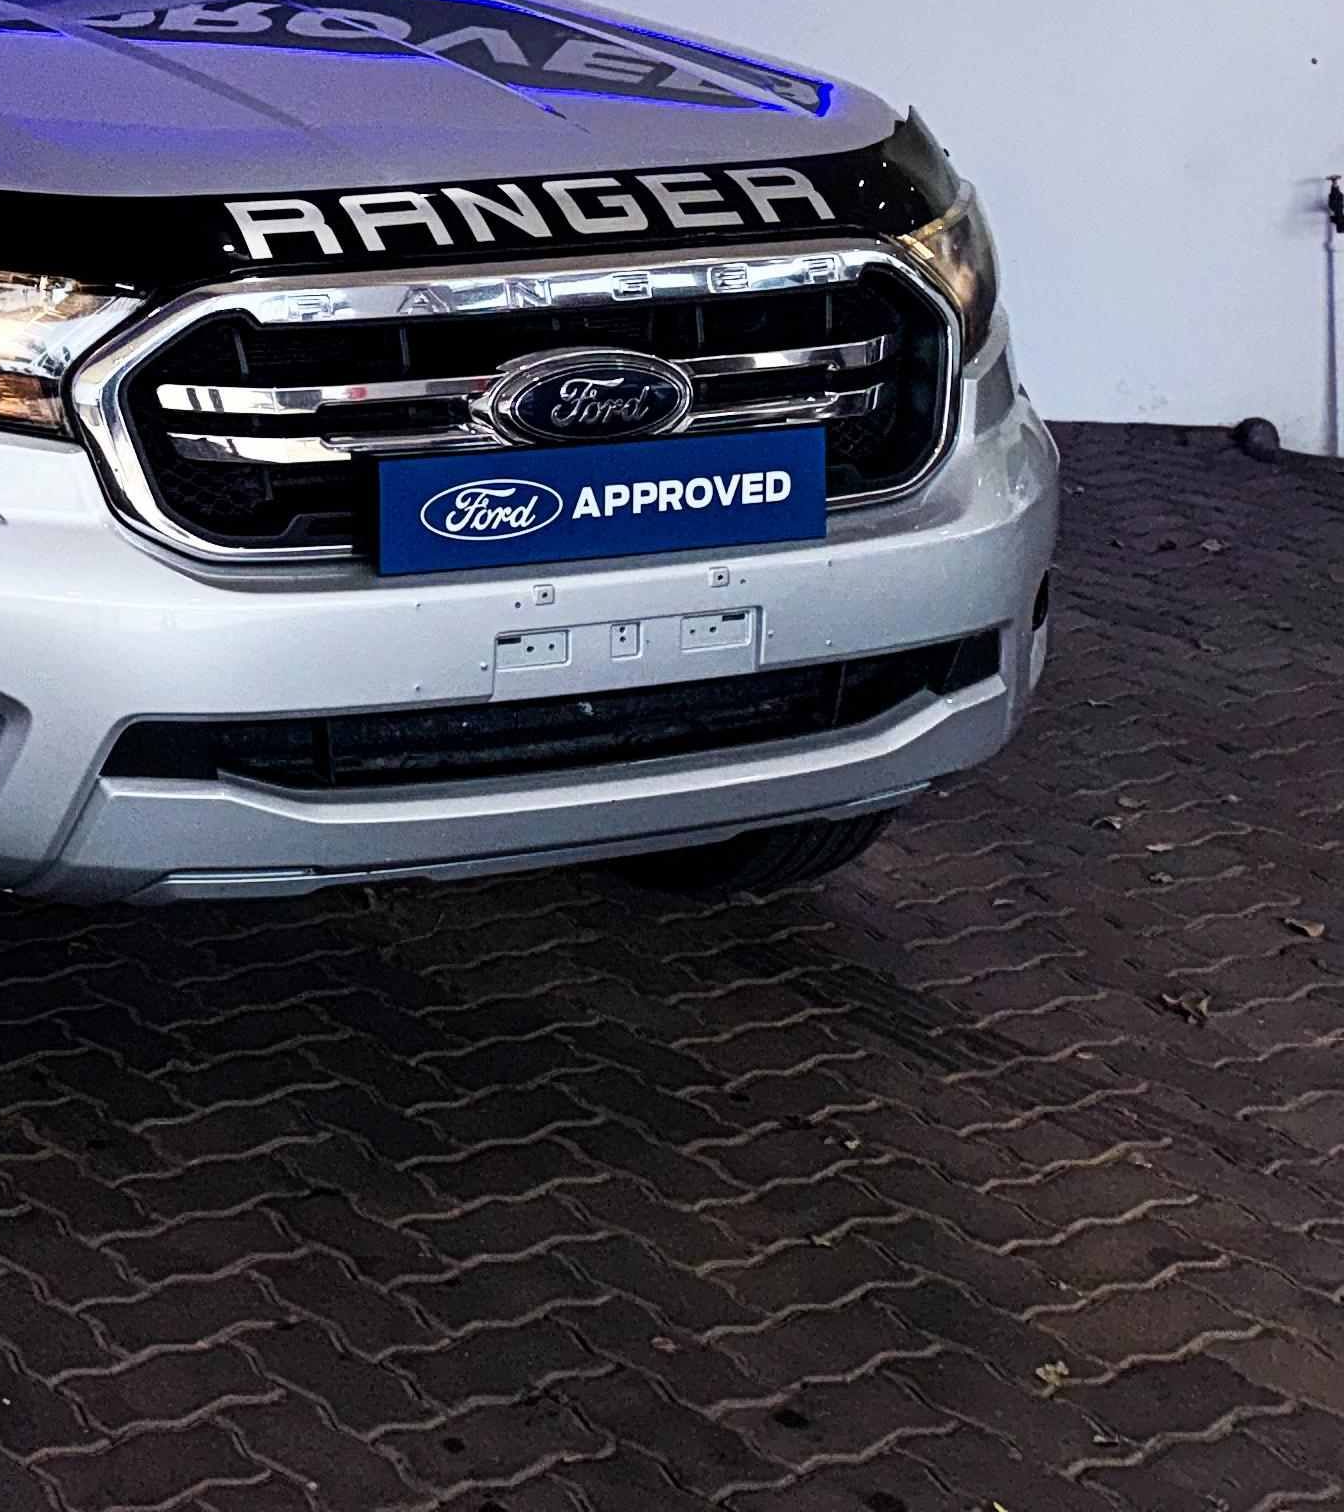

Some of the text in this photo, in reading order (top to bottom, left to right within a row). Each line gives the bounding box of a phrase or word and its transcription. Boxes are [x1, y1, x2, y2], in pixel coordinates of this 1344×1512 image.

[223, 166, 836, 260] RANGER
[550, 377, 650, 426] Ford
[445, 470, 791, 532] Ford APPROVED
